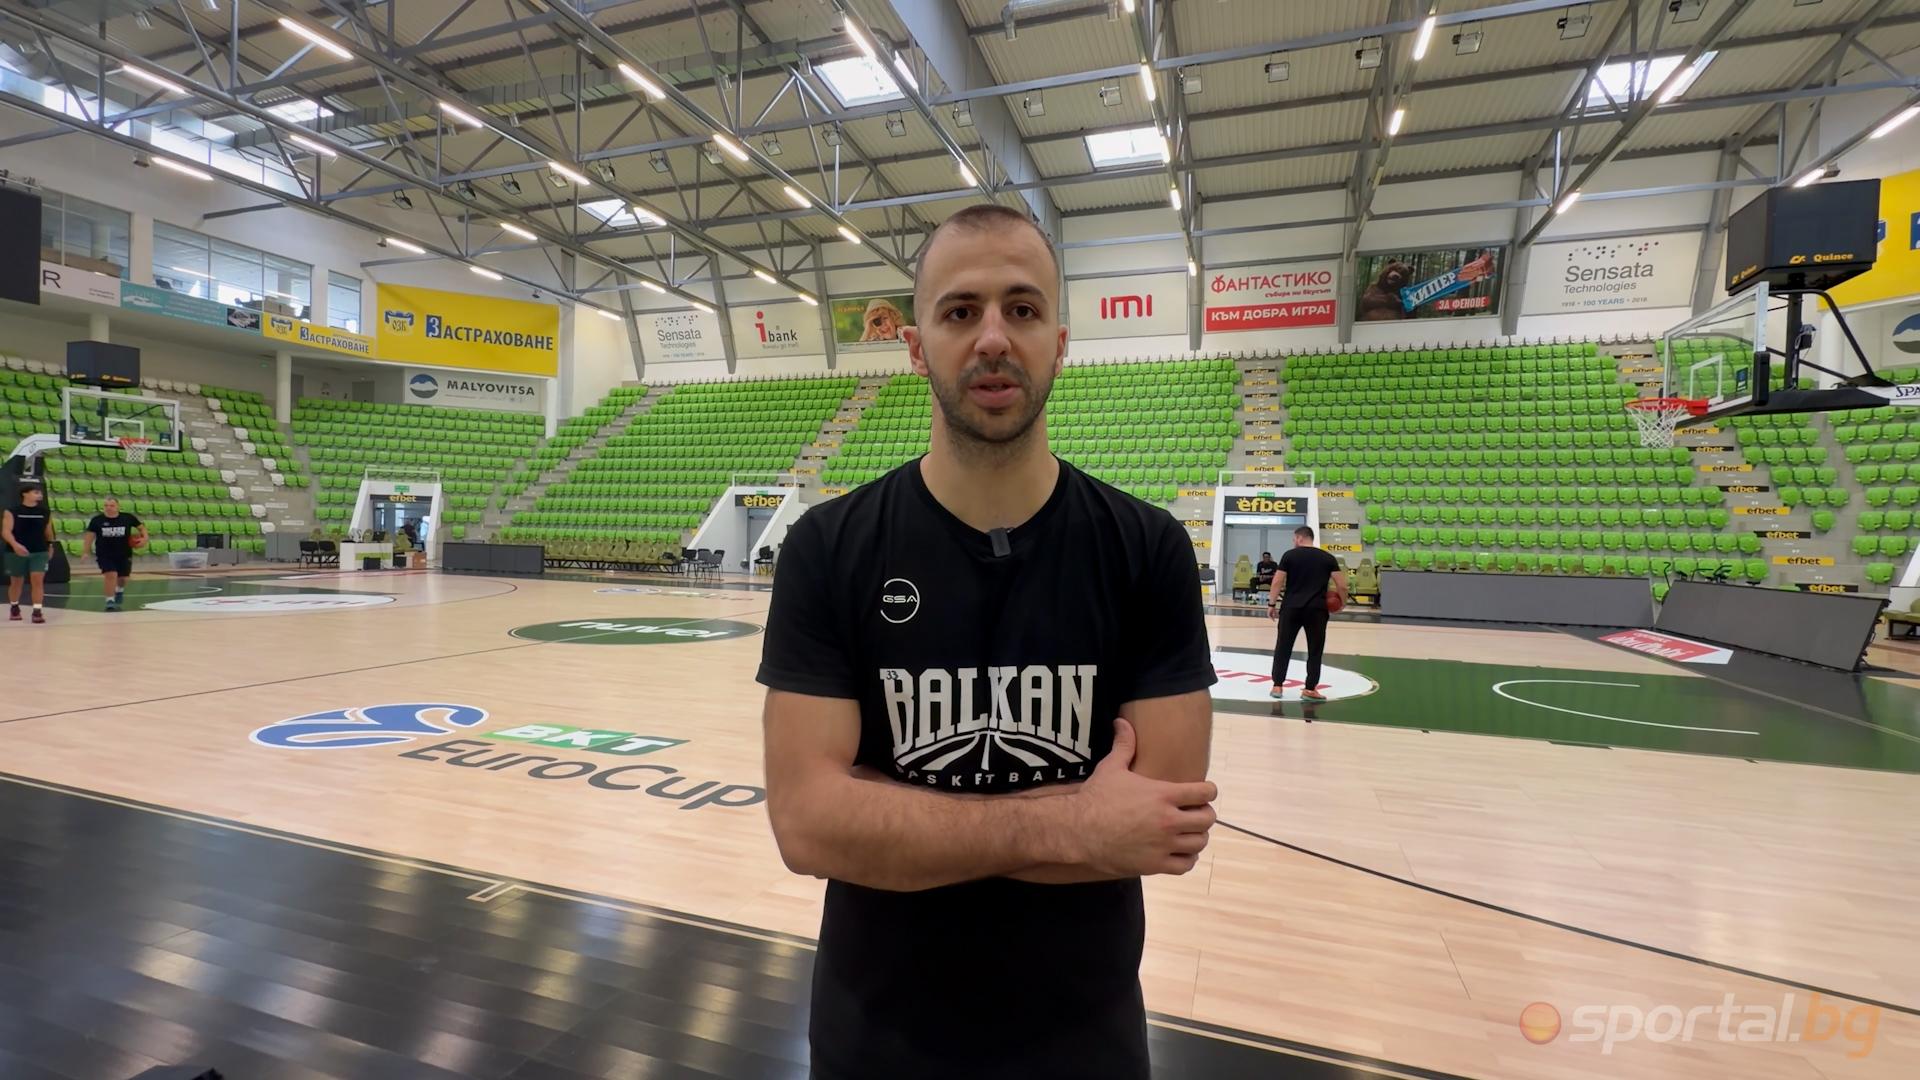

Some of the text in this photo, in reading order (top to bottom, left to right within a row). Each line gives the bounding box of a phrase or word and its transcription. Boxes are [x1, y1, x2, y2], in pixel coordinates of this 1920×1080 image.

[1813, 254, 1854, 263] Quince
[1564, 262, 1654, 282] Sensata
[1211, 271, 1331, 293] ФАНТАСТИКО
[1564, 282, 1637, 294] Technologies
[1438, 297, 1486, 309] ЗА ФЕНОВЕ
[1211, 305, 1331, 321] КЪМ ДОБРА ИГРА!
[426, 314, 553, 350] ЗАСТРАХОВАНЕ
[657, 329, 702, 341] Sensata
[300, 326, 369, 354] ЗАСТРАХОВАНЕ
[447, 380, 535, 396] MALYOVITSA
[743, 495, 782, 506] efbet
[1238, 498, 1297, 513] efbet
[1746, 507, 1777, 515] efbet
[1766, 531, 1799, 539] efbet
[1787, 557, 1820, 565] efbet
[1809, 584, 1845, 592] efbet
[882, 595, 918, 604] GSA
[879, 664, 1098, 760] BALKAN
[492, 724, 676, 753] BKT
[398, 739, 766, 810] EuroCup
